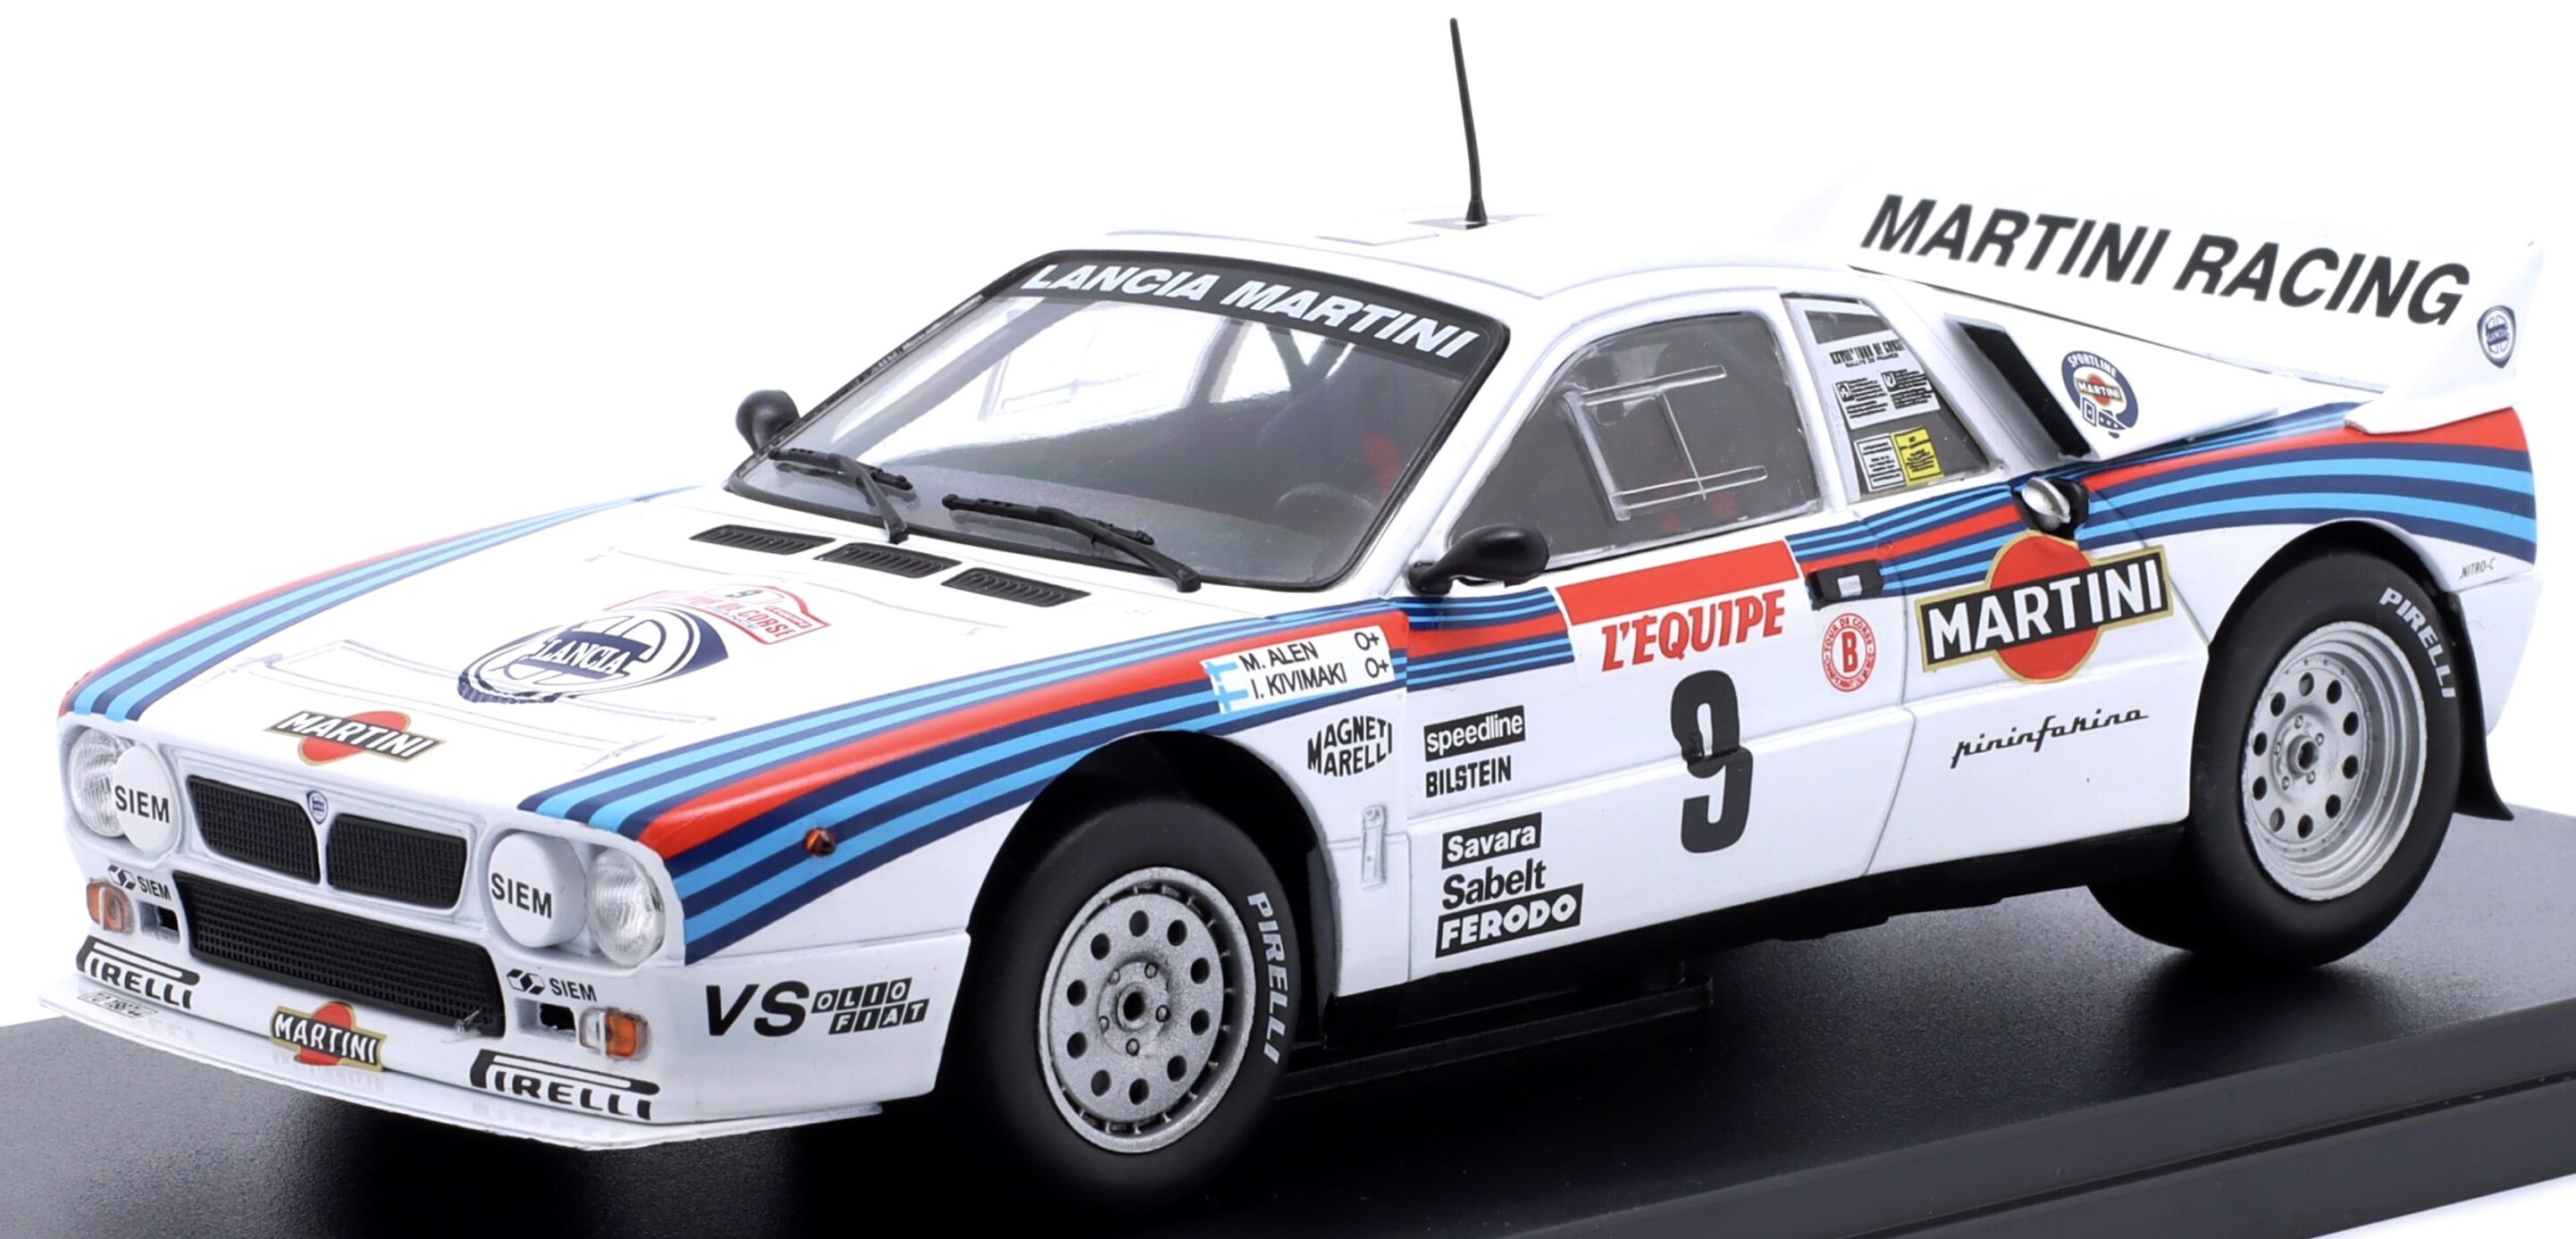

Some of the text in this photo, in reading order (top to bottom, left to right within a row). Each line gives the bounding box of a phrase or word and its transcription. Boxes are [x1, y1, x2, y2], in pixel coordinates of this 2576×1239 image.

[1859, 194, 2471, 326] MARTINI RACING
[1020, 264, 1481, 358] LANCIA MARTINI
[2077, 381, 2121, 399] MARTINI
[2460, 557, 2496, 579] NITRO-C
[1928, 558, 2162, 660] MARTINI
[534, 637, 631, 674] LANCIA
[1239, 653, 1266, 673] M.
[1269, 642, 1319, 666] ALEN
[1842, 632, 1859, 673] B
[2379, 587, 2456, 699] PIRELLI
[1251, 679, 1264, 699] I.
[1268, 663, 1347, 697] KIVIMAKI
[277, 712, 434, 758] MARTINI
[1307, 715, 1393, 758] MAGNETI
[1426, 712, 1524, 757] speedline
[1951, 708, 2149, 769] pininfarina
[1307, 738, 1393, 777] MARELLI
[1425, 755, 1512, 798] BILSTEIN
[1671, 670, 1754, 854] 9
[114, 784, 170, 824] SIEM
[1447, 825, 1537, 863] Savara
[137, 875, 172, 901] SIEM
[491, 872, 552, 919] SIEM
[1441, 858, 1547, 910] Sabelt
[1441, 893, 1579, 951] FERODO
[75, 934, 201, 1010] PIRELLI
[550, 978, 597, 1002] SIEM
[1247, 892, 1288, 1065] PIRELLI
[706, 980, 908, 1037] VS OLIO
[835, 1002, 927, 1032] FIAT
[274, 1014, 377, 1065] MARTINI
[469, 1048, 660, 1120] PIRELLI
